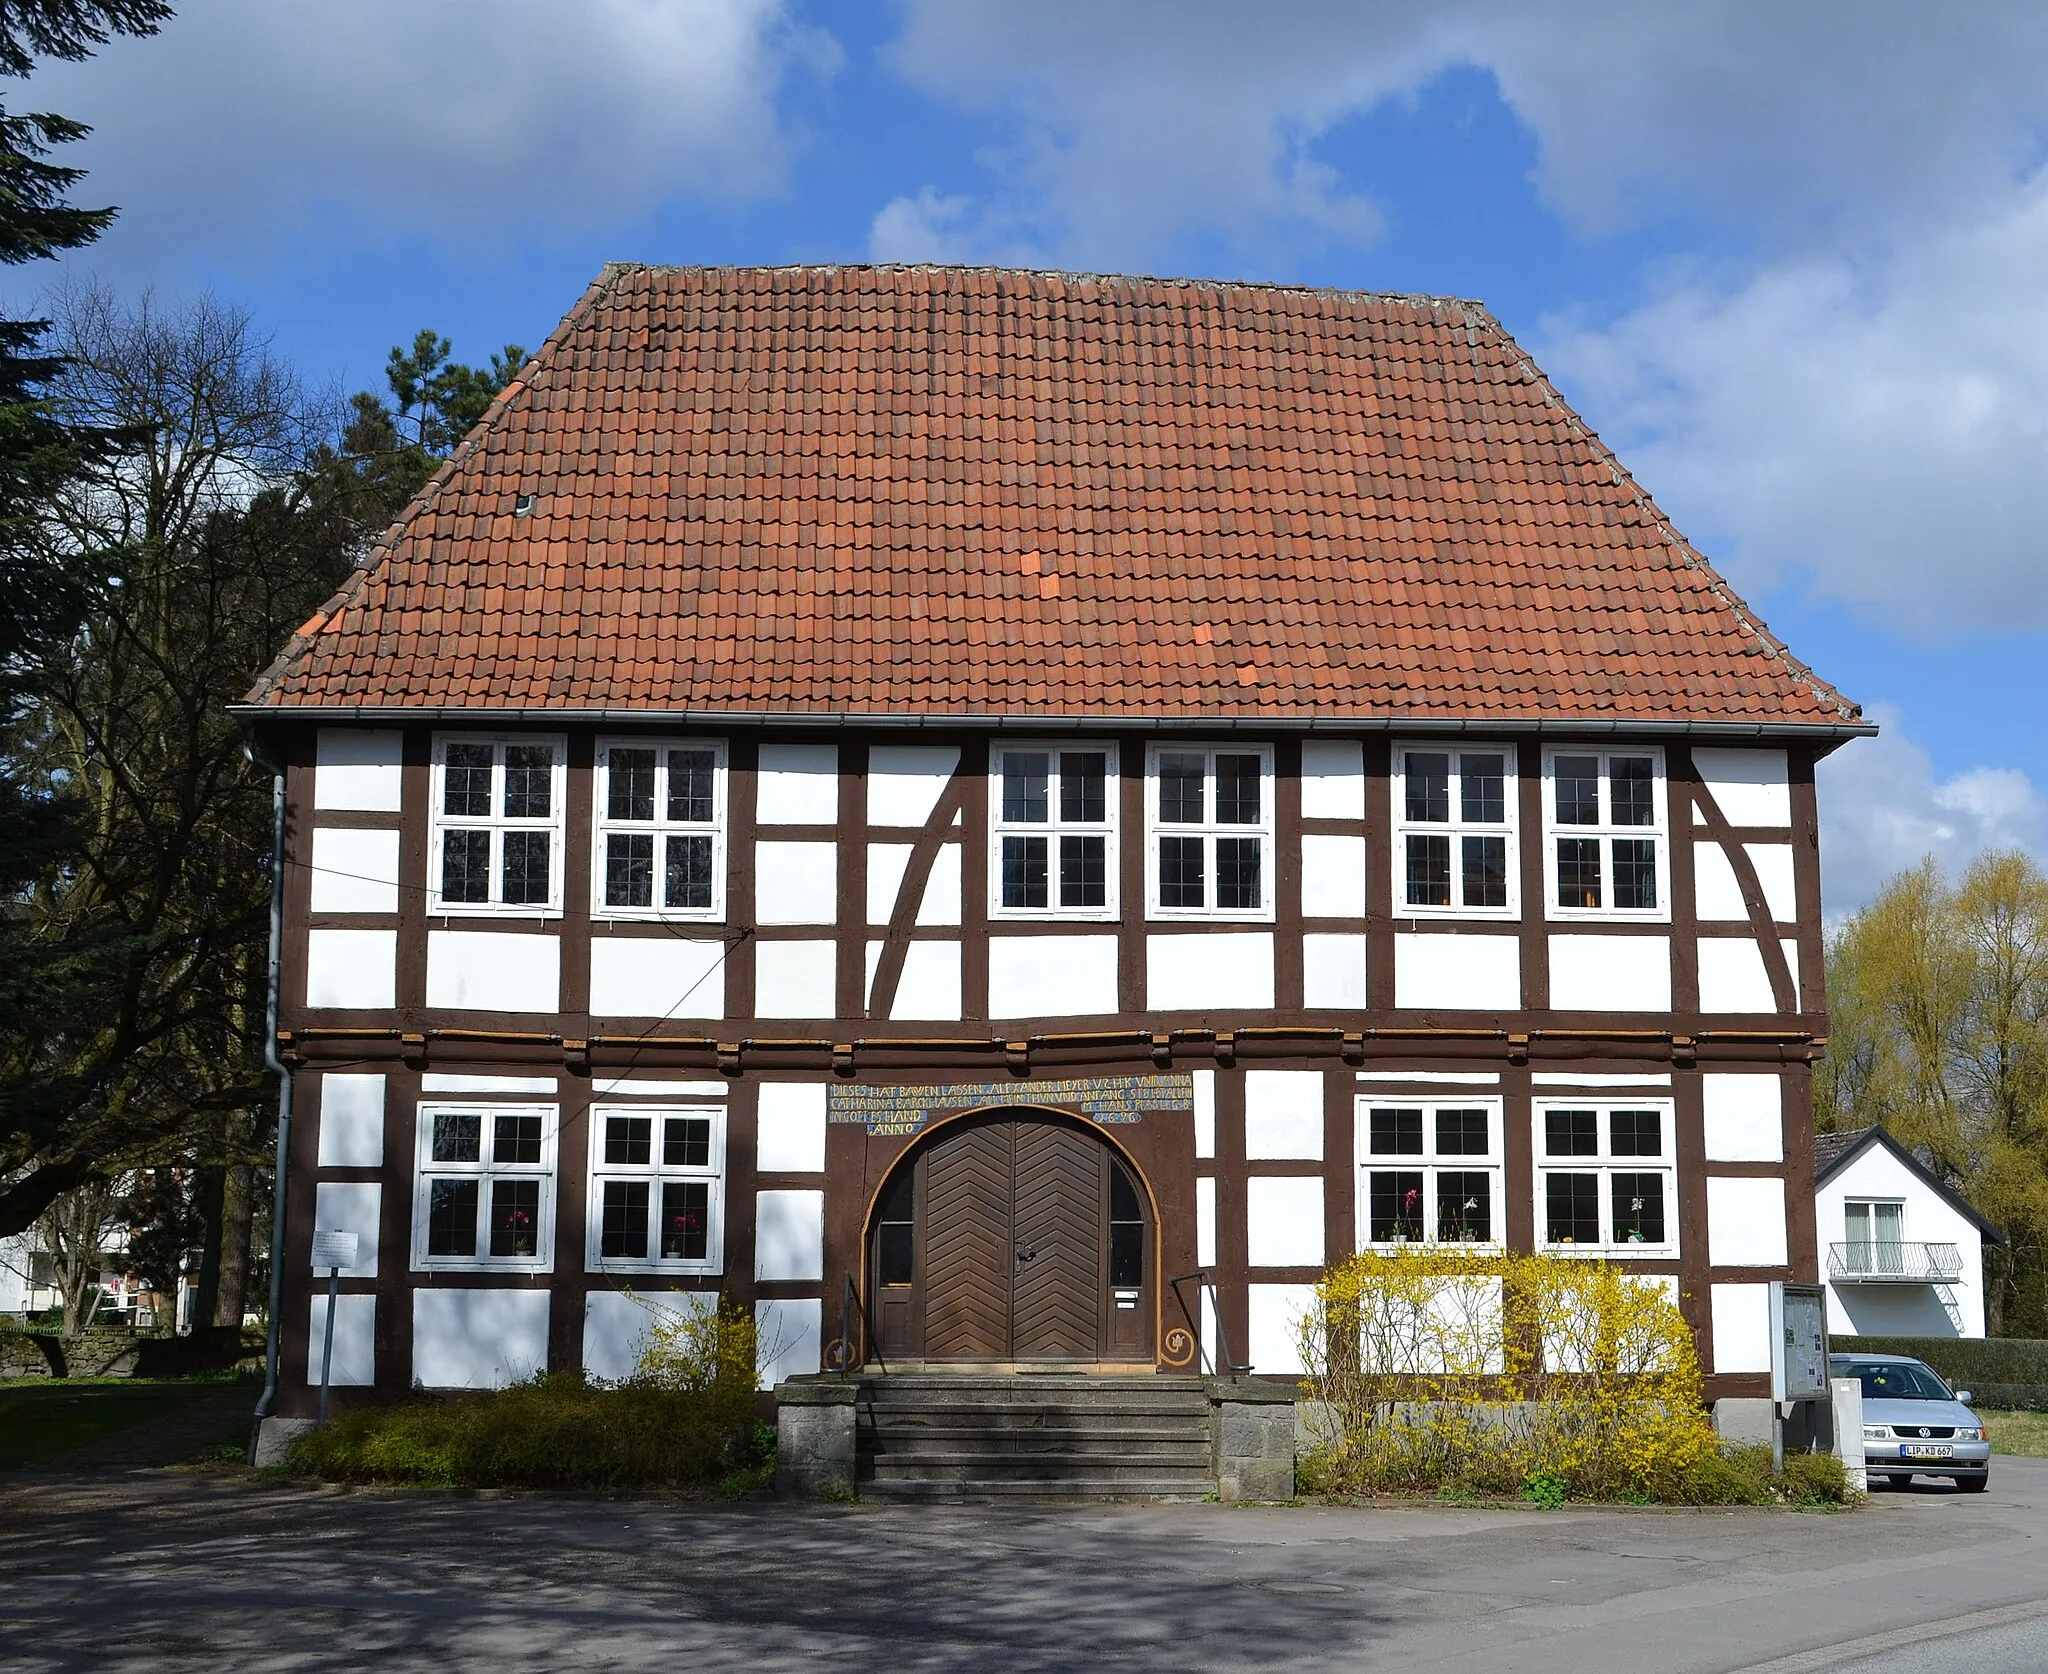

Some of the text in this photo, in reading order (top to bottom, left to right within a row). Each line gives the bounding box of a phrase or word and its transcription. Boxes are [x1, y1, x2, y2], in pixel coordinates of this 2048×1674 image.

[832, 1084, 867, 1097] DIESES
[870, 1086, 896, 1097] HAT
[942, 1084, 982, 1096] LASSEN
[987, 1081, 1054, 1095] ALEXANDER
[1057, 1079, 1089, 1092] MEYER
[885, 1110, 921, 1122] HAND
[869, 1123, 914, 1136] ANNO
[1907, 1446, 1921, 1455] LIP
